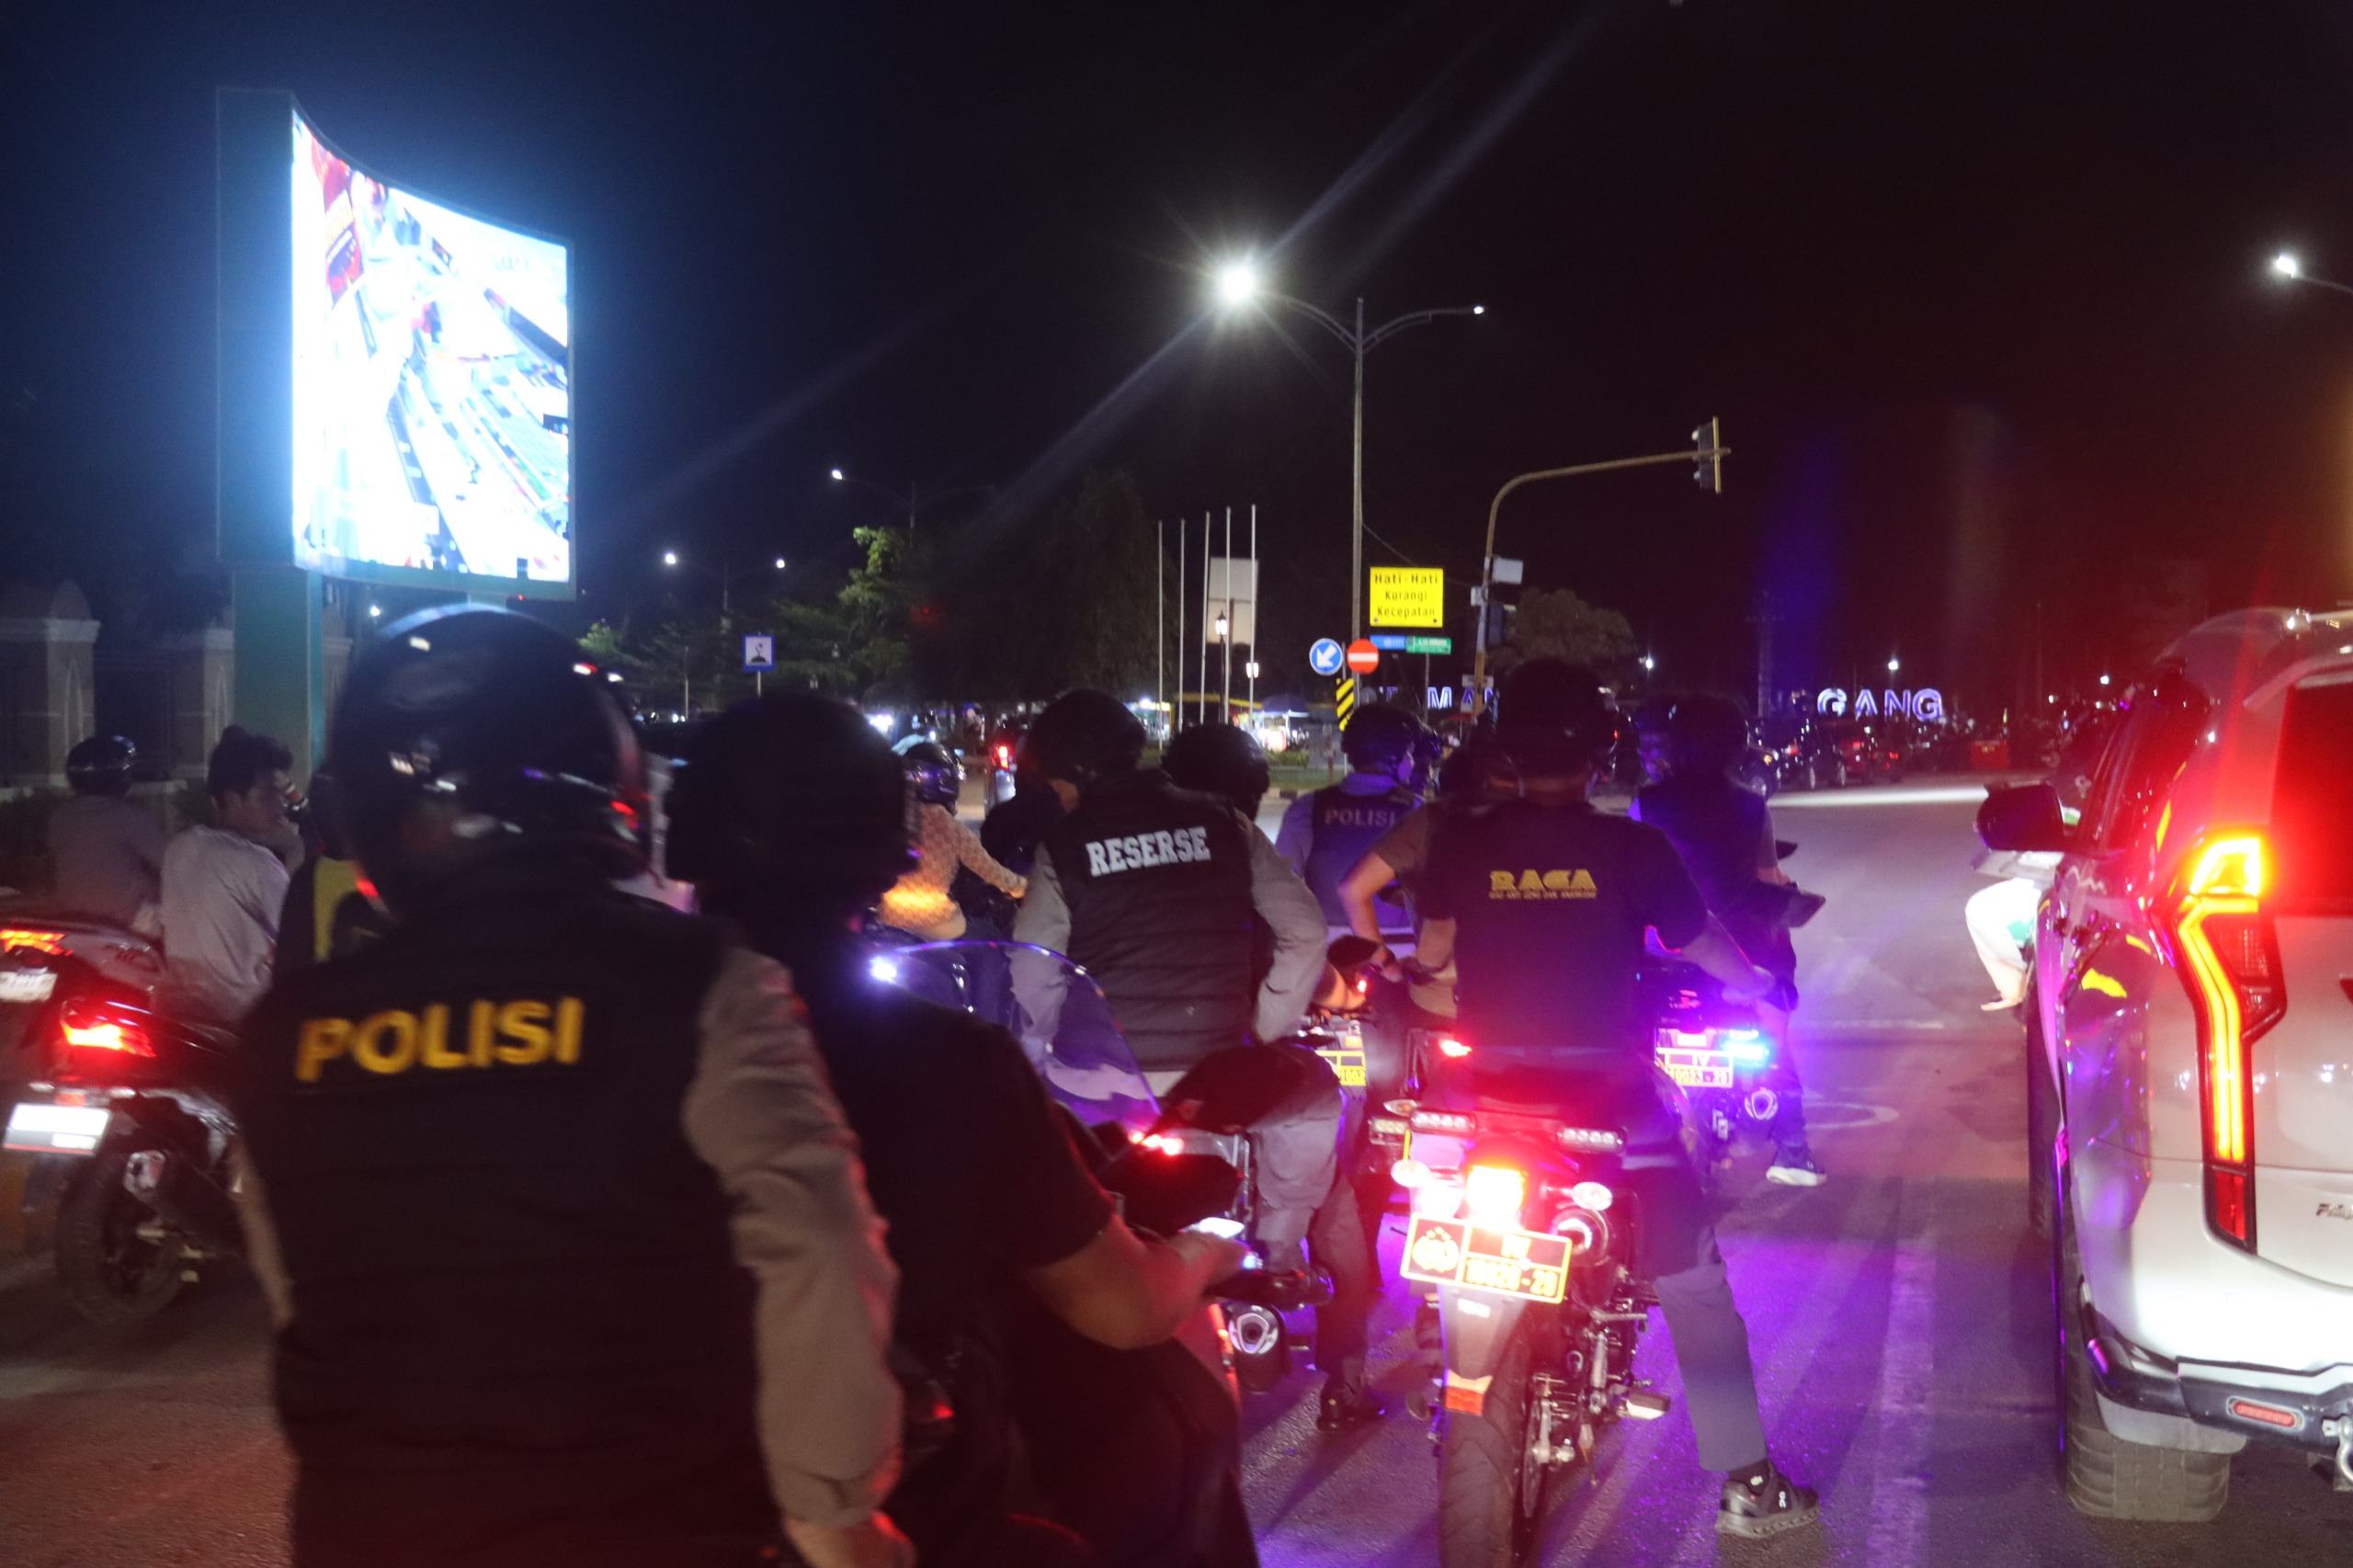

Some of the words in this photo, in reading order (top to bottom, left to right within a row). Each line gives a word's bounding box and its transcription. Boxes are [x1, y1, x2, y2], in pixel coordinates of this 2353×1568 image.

[1374, 573, 1438, 585] Hati-Hati
[1385, 589, 1428, 603] Kurangi
[1377, 606, 1436, 620] Kecepatan
[1816, 687, 1943, 722] GANG
[1324, 808, 1396, 828] POLISI
[1085, 825, 1211, 878] RESERSE
[295, 995, 585, 1083] POLISI
